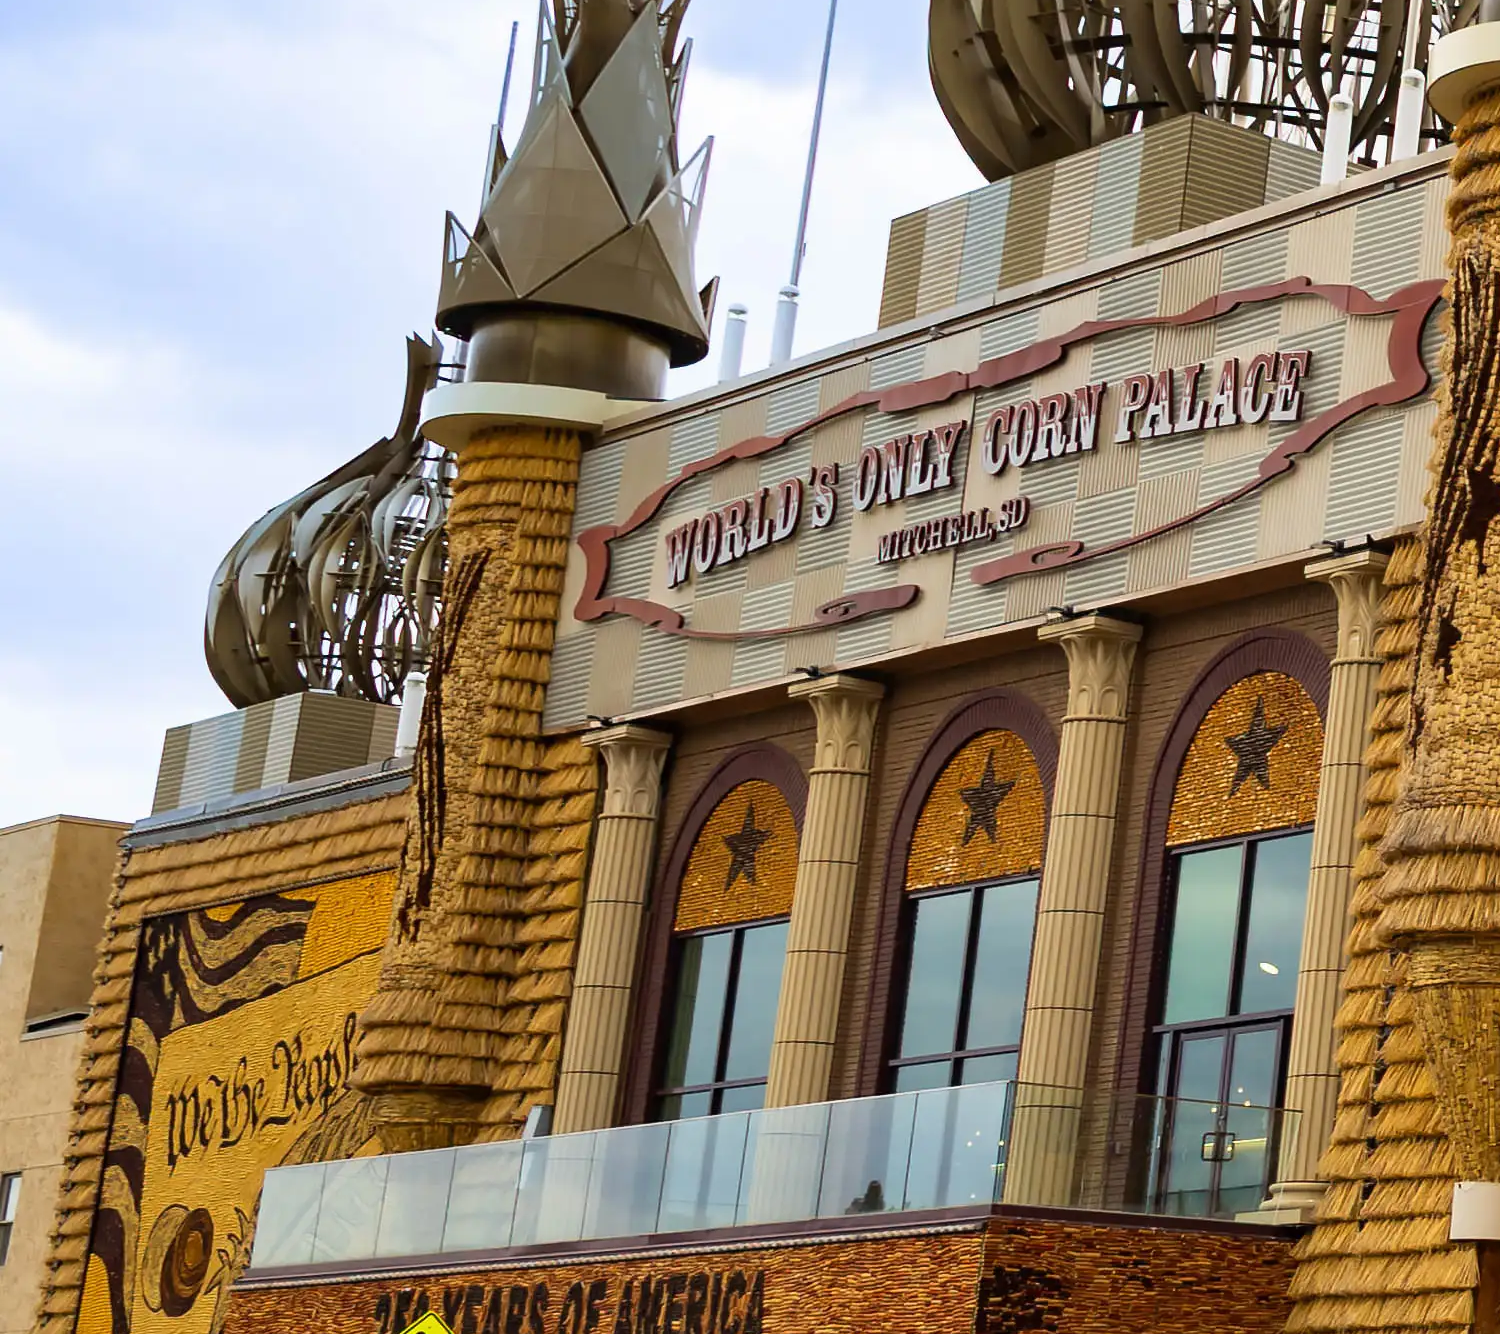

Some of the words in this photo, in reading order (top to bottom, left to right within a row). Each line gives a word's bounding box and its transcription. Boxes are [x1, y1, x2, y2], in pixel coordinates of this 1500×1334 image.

[666, 462, 839, 589] WORLD'S
[852, 420, 967, 512] ONLY
[982, 381, 1107, 476] CORN
[1114, 349, 1312, 444] PALACE
[877, 507, 997, 565] MITCHELL,
[997, 495, 1031, 533] SD
[165, 1075, 213, 1177] We
